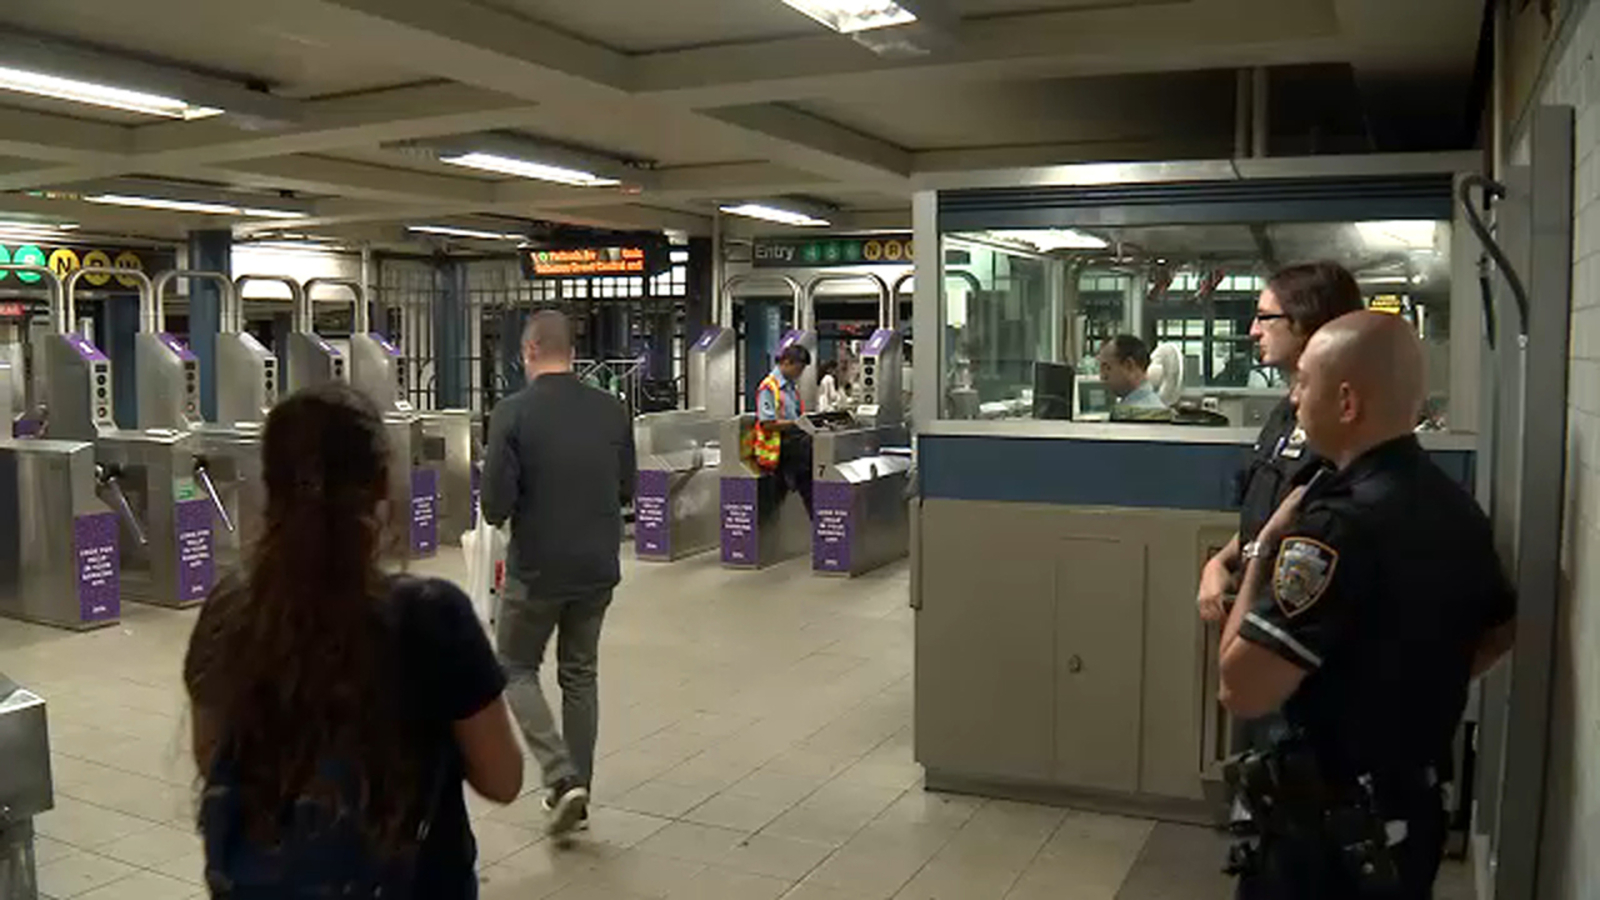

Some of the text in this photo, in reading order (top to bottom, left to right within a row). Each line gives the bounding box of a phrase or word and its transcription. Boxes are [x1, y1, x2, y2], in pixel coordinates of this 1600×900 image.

[754, 243, 796, 262] Entry
[56, 257, 71, 276] N
[819, 464, 826, 478] 7
